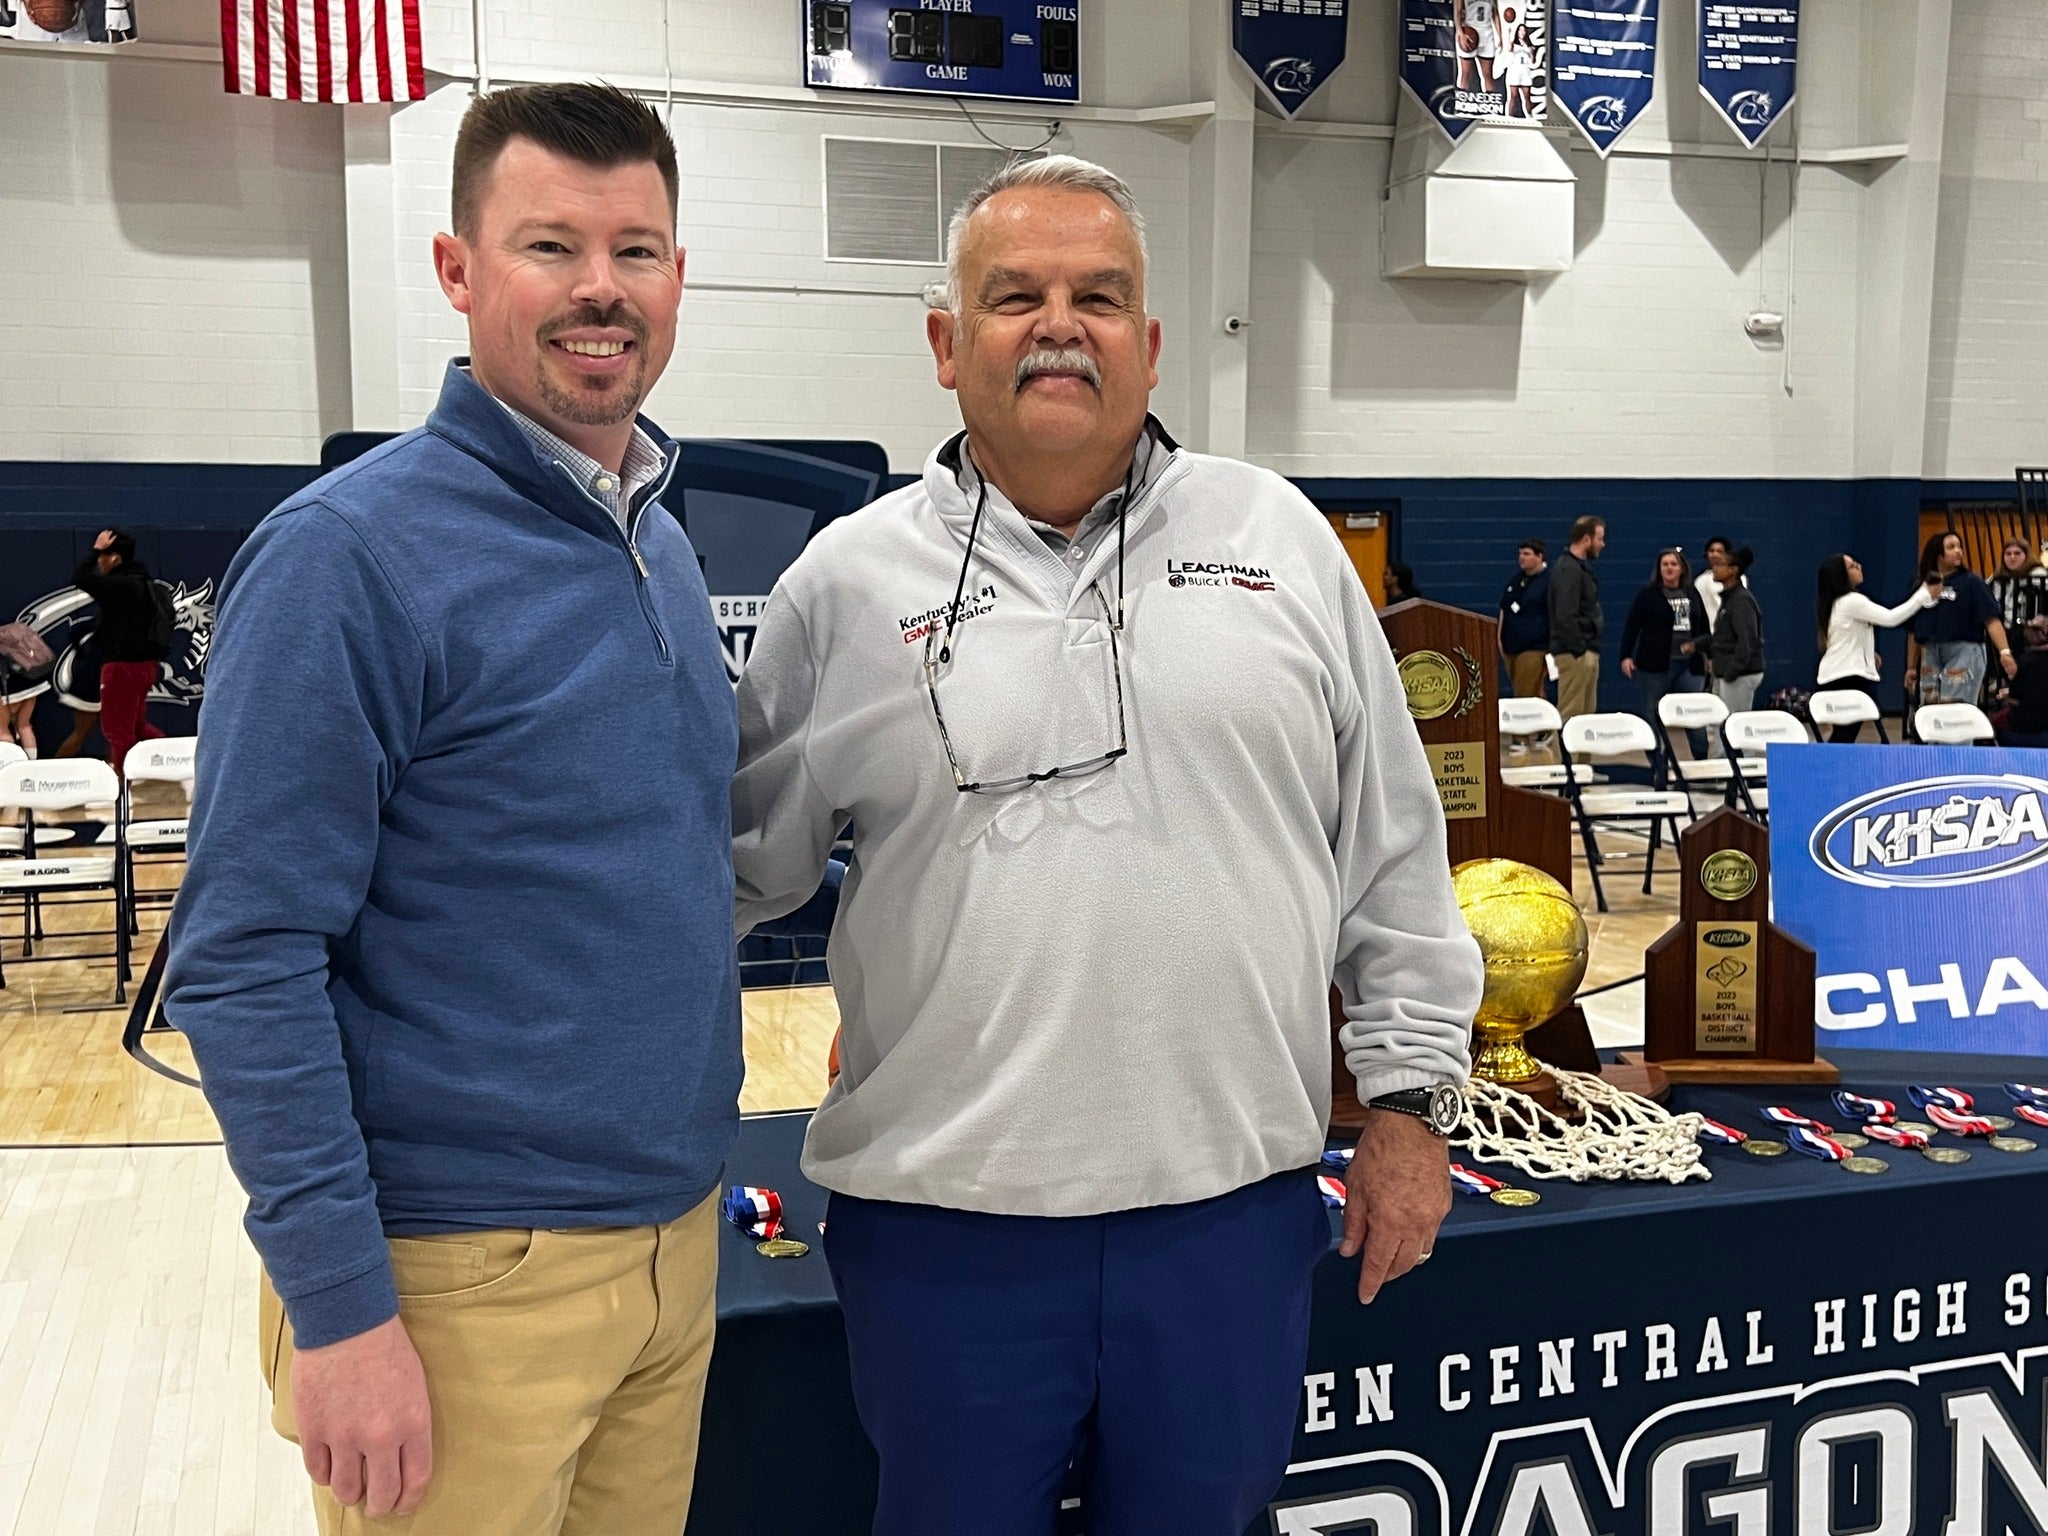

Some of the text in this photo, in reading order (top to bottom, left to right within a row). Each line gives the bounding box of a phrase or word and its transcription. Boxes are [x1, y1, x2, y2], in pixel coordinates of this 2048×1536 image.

[920, 0, 972, 13] PLAYER
[1036, 5, 1077, 21] FOULS
[926, 65, 968, 81] GAME
[1043, 73, 1072, 88] WON
[1167, 559, 1271, 579] LEACHMAN
[1188, 577, 1220, 587] BUICK
[981, 585, 998, 601] #1
[1444, 751, 1464, 761] 2023
[1444, 764, 1465, 773] BOYS
[1435, 776, 1480, 787] ASKETBALL
[1443, 790, 1467, 800] STATE
[1853, 793, 2048, 867] KHSAA
[1815, 957, 2048, 1031] CHA
[1716, 1002, 1736, 1011] BOYS
[1701, 1012, 1750, 1022] BASKETBALL
[1704, 1035, 1747, 1044] CHAMPION
[1439, 1310, 1774, 1413] CENTRAL
[1813, 1280, 1968, 1356] HIGH
